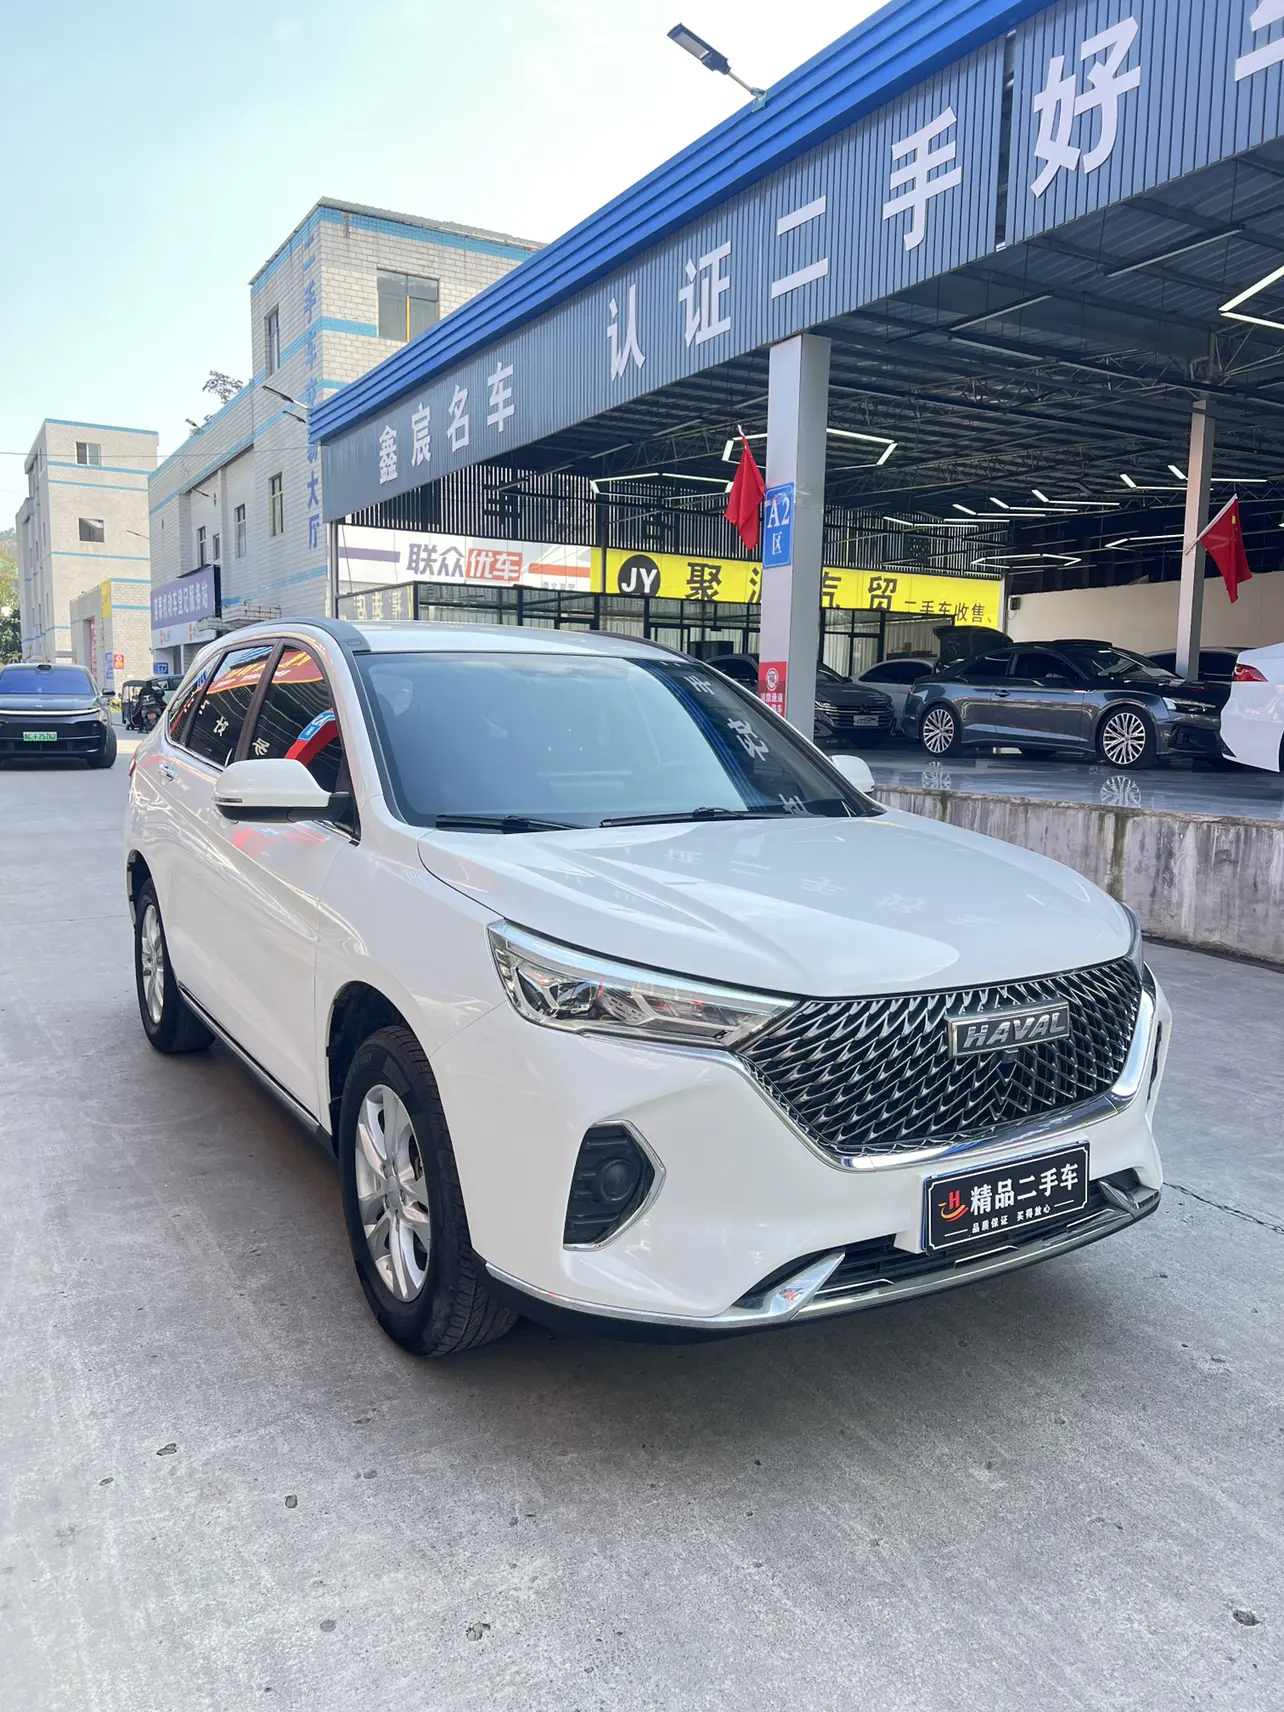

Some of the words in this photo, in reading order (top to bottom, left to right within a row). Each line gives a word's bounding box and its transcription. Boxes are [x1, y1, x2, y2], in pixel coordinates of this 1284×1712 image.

[378, 362, 516, 484] 鑫宸名车
[766, 496, 790, 529] A2
[771, 531, 783, 556] 区
[406, 542, 521, 580] 联众优车
[620, 566, 659, 593] JY
[963, 1012, 1067, 1048] HAVAL
[970, 1163, 1079, 1216] 精品二手车
[972, 1215, 1009, 1234] 品质保证
[1016, 1204, 1051, 1221] 买得放心
